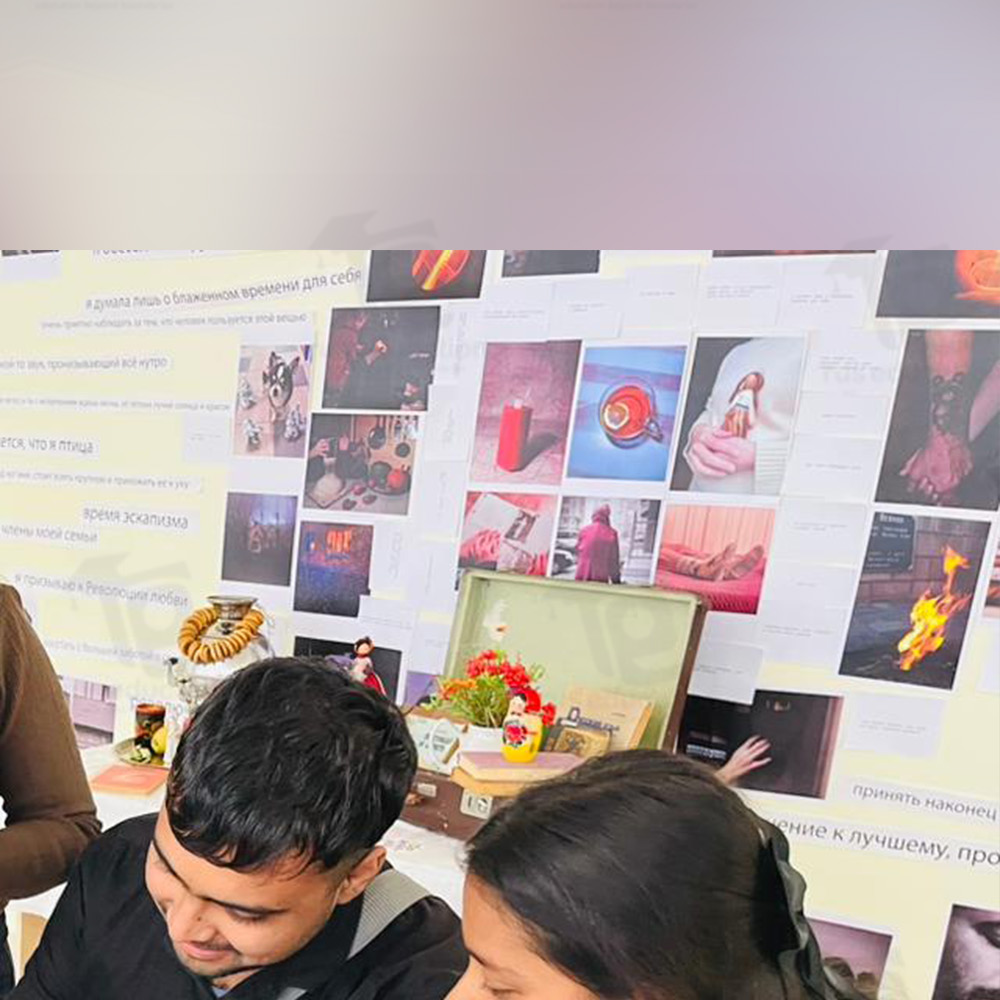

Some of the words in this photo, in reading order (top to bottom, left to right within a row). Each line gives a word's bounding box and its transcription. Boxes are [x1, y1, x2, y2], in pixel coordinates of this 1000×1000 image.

[162, 295, 172, 306] о
[240, 280, 300, 300] времени
[302, 275, 328, 293] для
[330, 266, 363, 286] себя
[28, 438, 47, 451] что
[49, 440, 57, 451] я
[58, 440, 94, 455] птица
[83, 507, 121, 523] время
[123, 510, 190, 530] эскапизма
[852, 782, 922, 806] принять
[925, 798, 997, 822] наконец
[832, 828, 844, 841] к
[957, 845, 1000, 867] про
